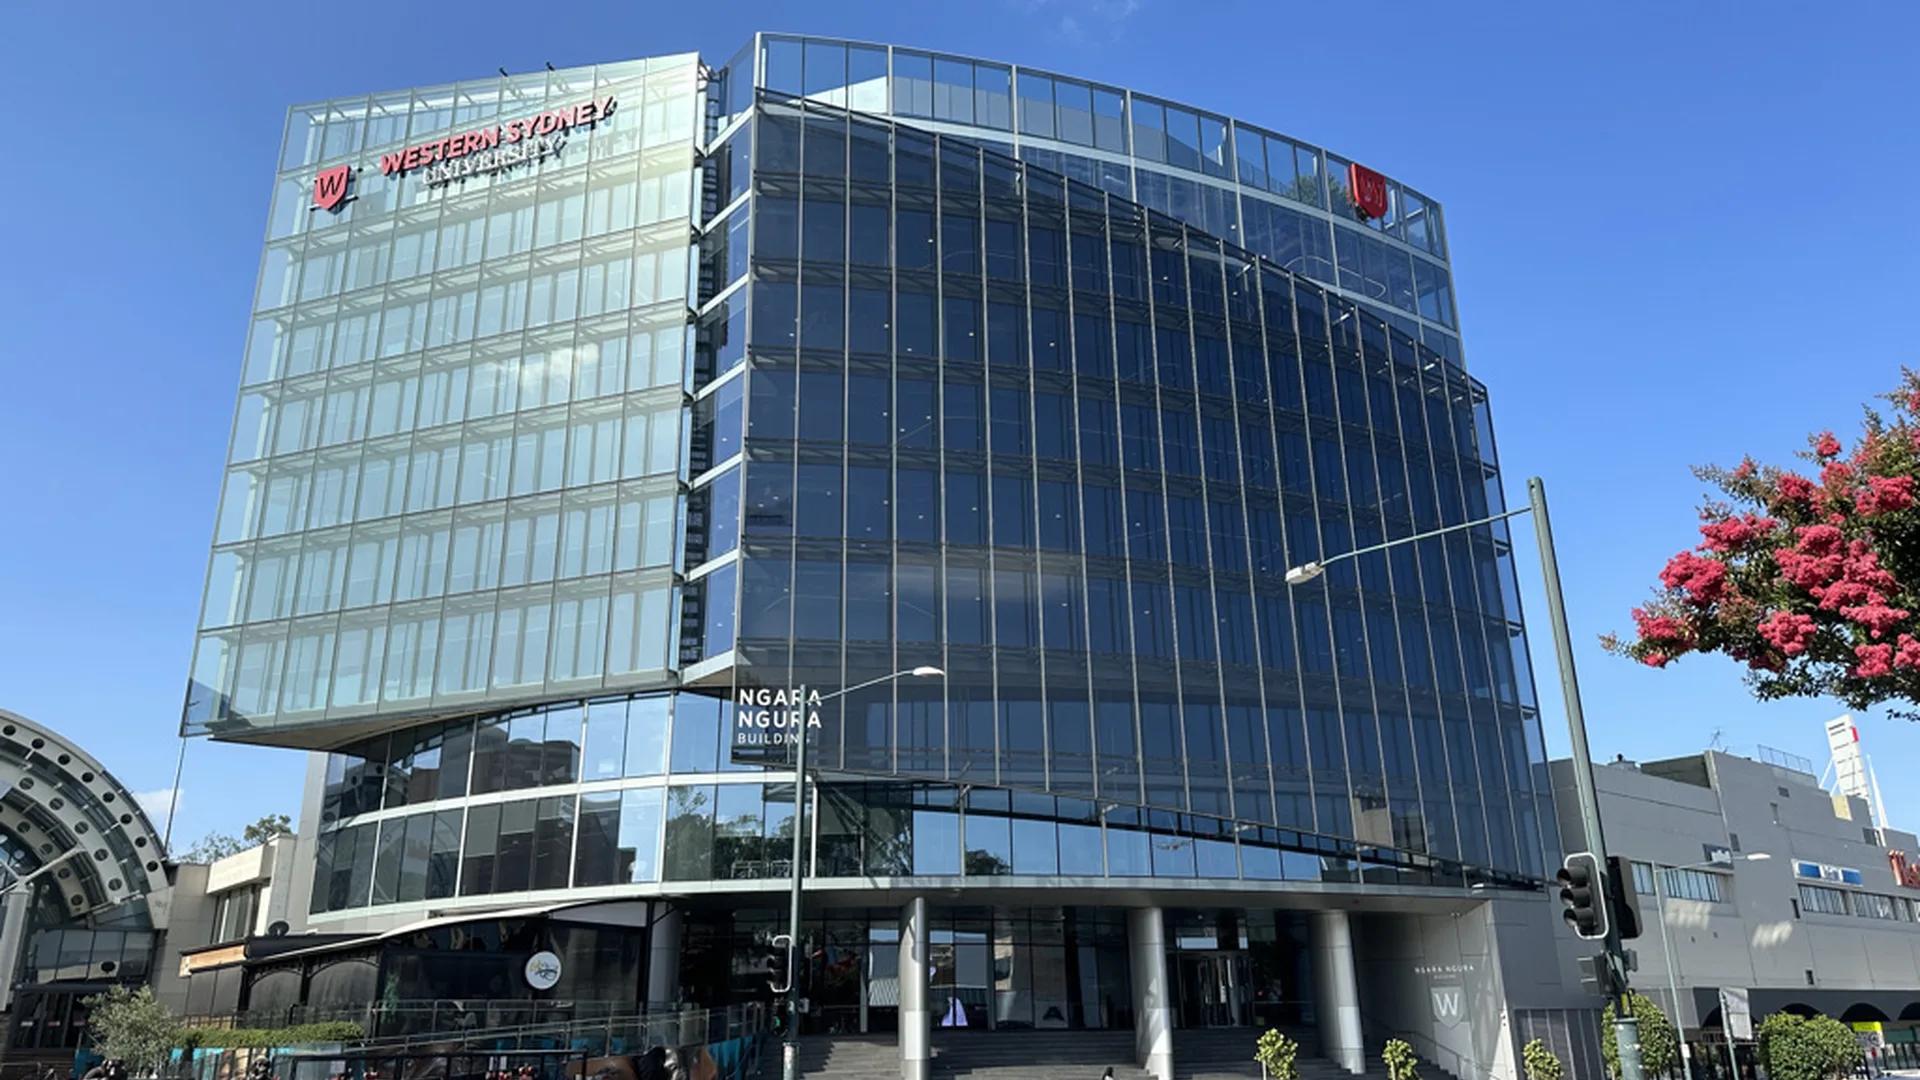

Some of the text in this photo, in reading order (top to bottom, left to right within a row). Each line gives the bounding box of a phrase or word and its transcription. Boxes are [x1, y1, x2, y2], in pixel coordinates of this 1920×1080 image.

[381, 96, 614, 176] WESTERN SYDNEY
[422, 136, 561, 185] UNIVERSITY
[320, 171, 345, 199] W
[738, 733, 812, 744] BUILDIN
[1434, 992, 1459, 1017] W
